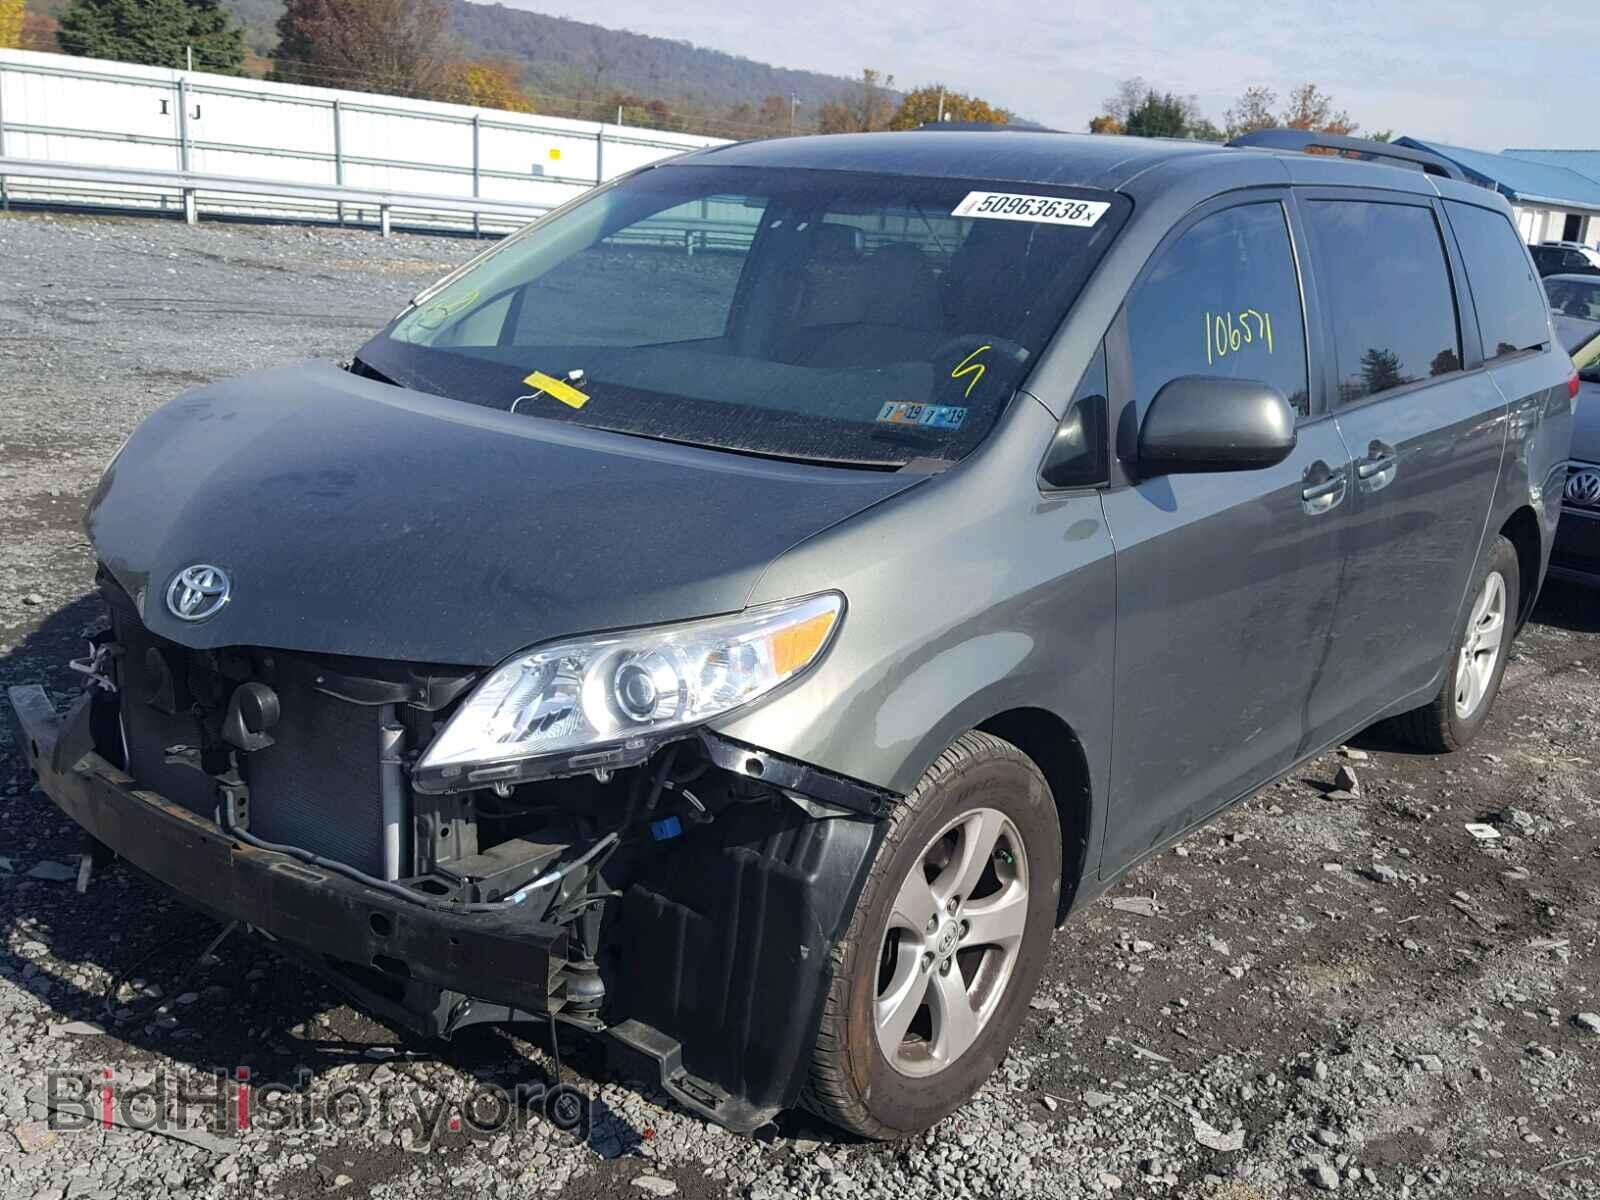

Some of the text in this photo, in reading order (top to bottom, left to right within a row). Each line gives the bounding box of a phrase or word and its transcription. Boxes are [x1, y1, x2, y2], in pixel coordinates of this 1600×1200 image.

[159, 99, 169, 115] I
[191, 104, 201, 120] J
[1206, 308, 1273, 366] 106571
